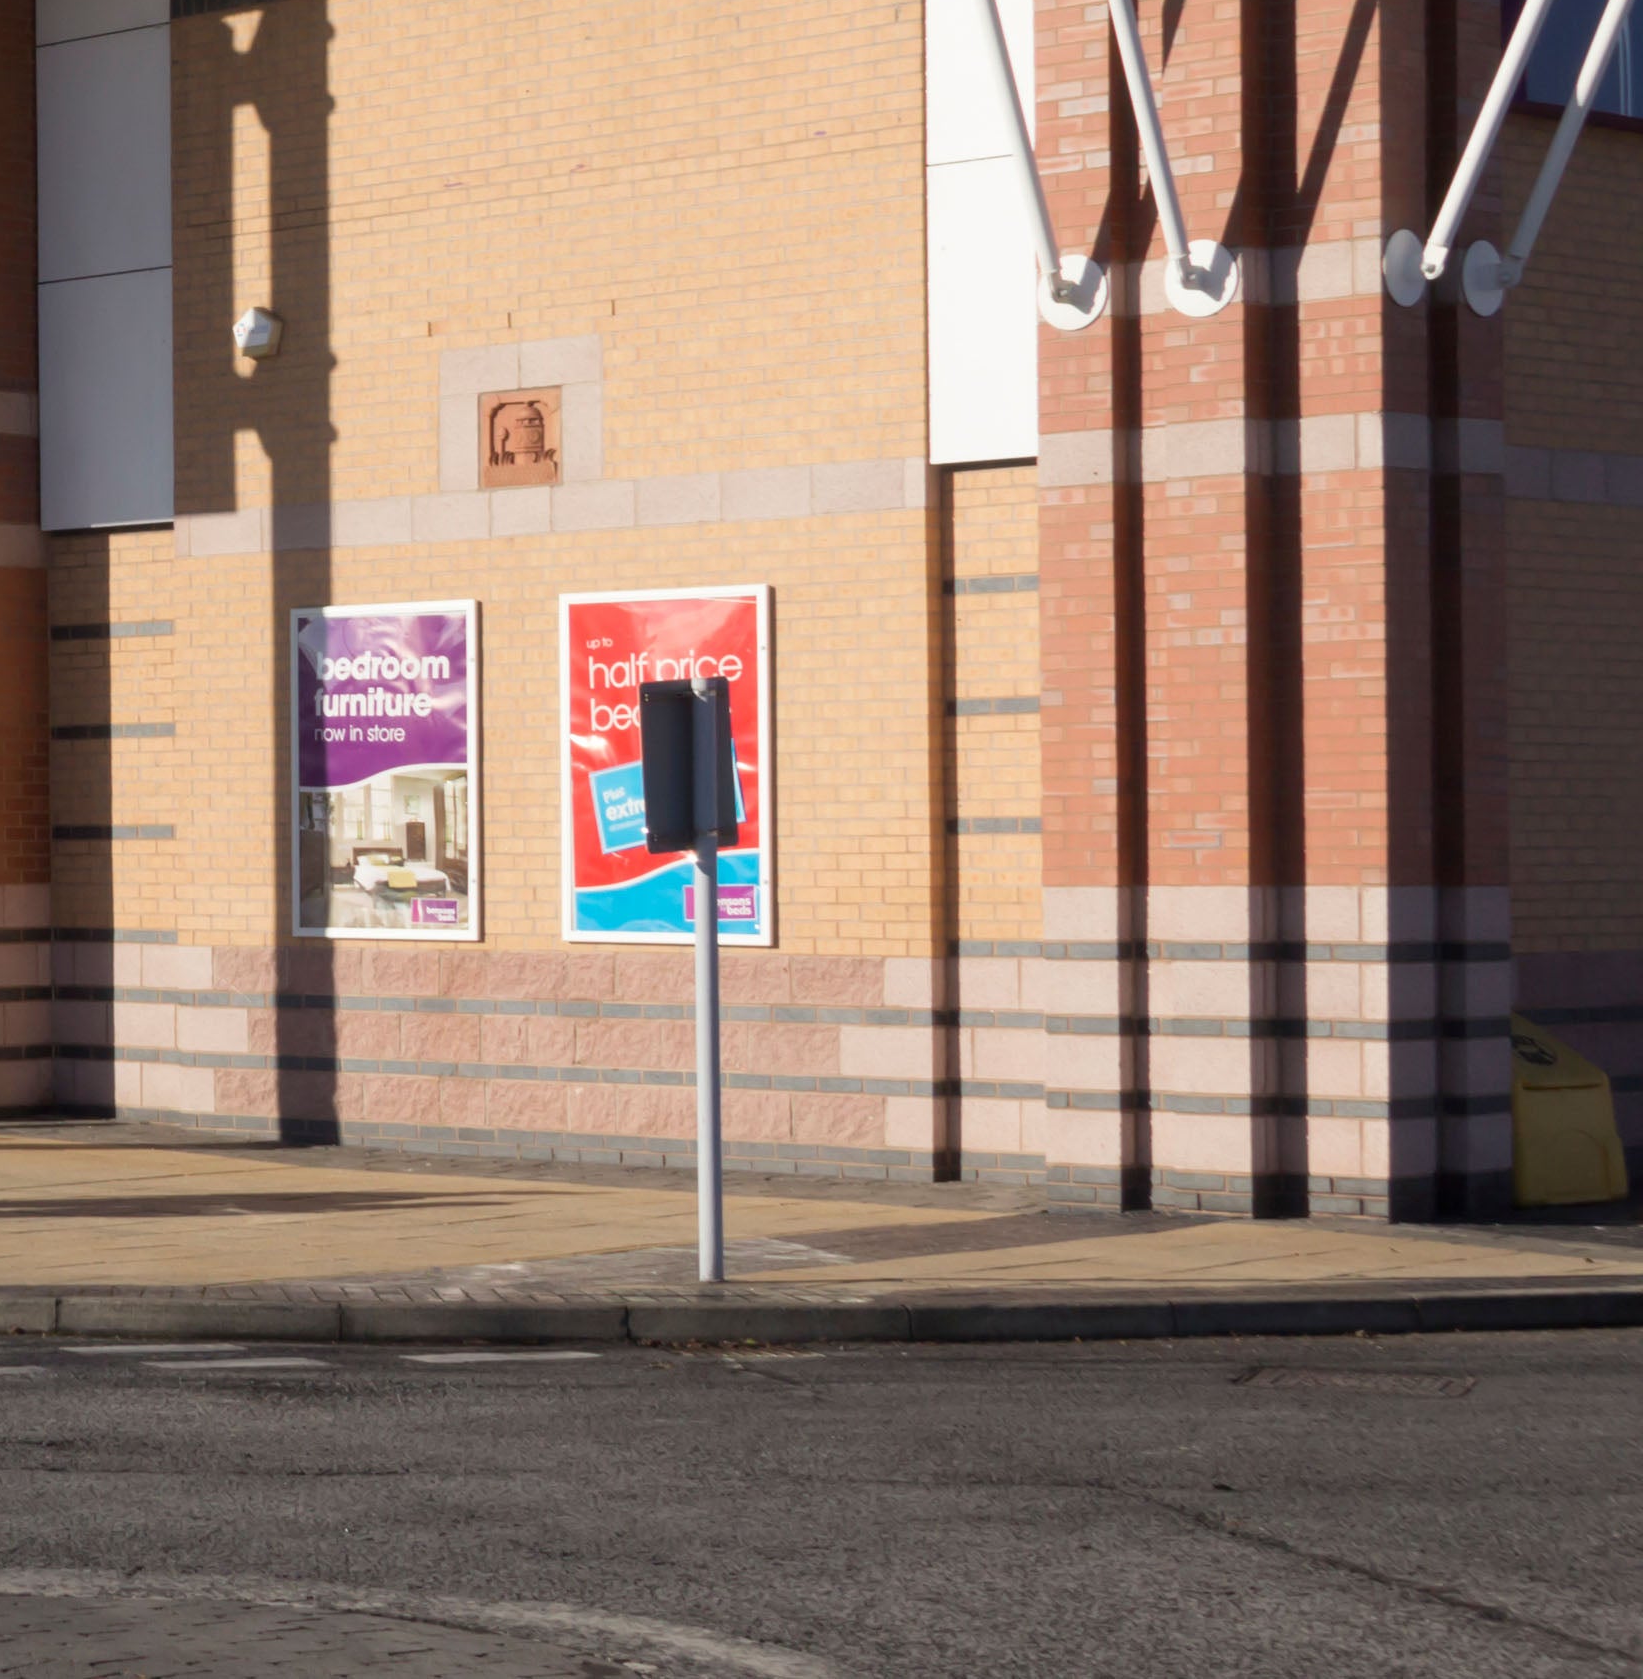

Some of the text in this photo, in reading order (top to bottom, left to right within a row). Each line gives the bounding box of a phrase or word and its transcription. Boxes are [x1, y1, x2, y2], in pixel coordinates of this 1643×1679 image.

[586, 637, 613, 650] up to
[316, 650, 450, 680] bedroom
[589, 649, 743, 690] half price
[315, 687, 433, 718] furniture
[590, 698, 642, 732] be
[314, 724, 407, 742] now in store
[605, 797, 646, 821] extr
